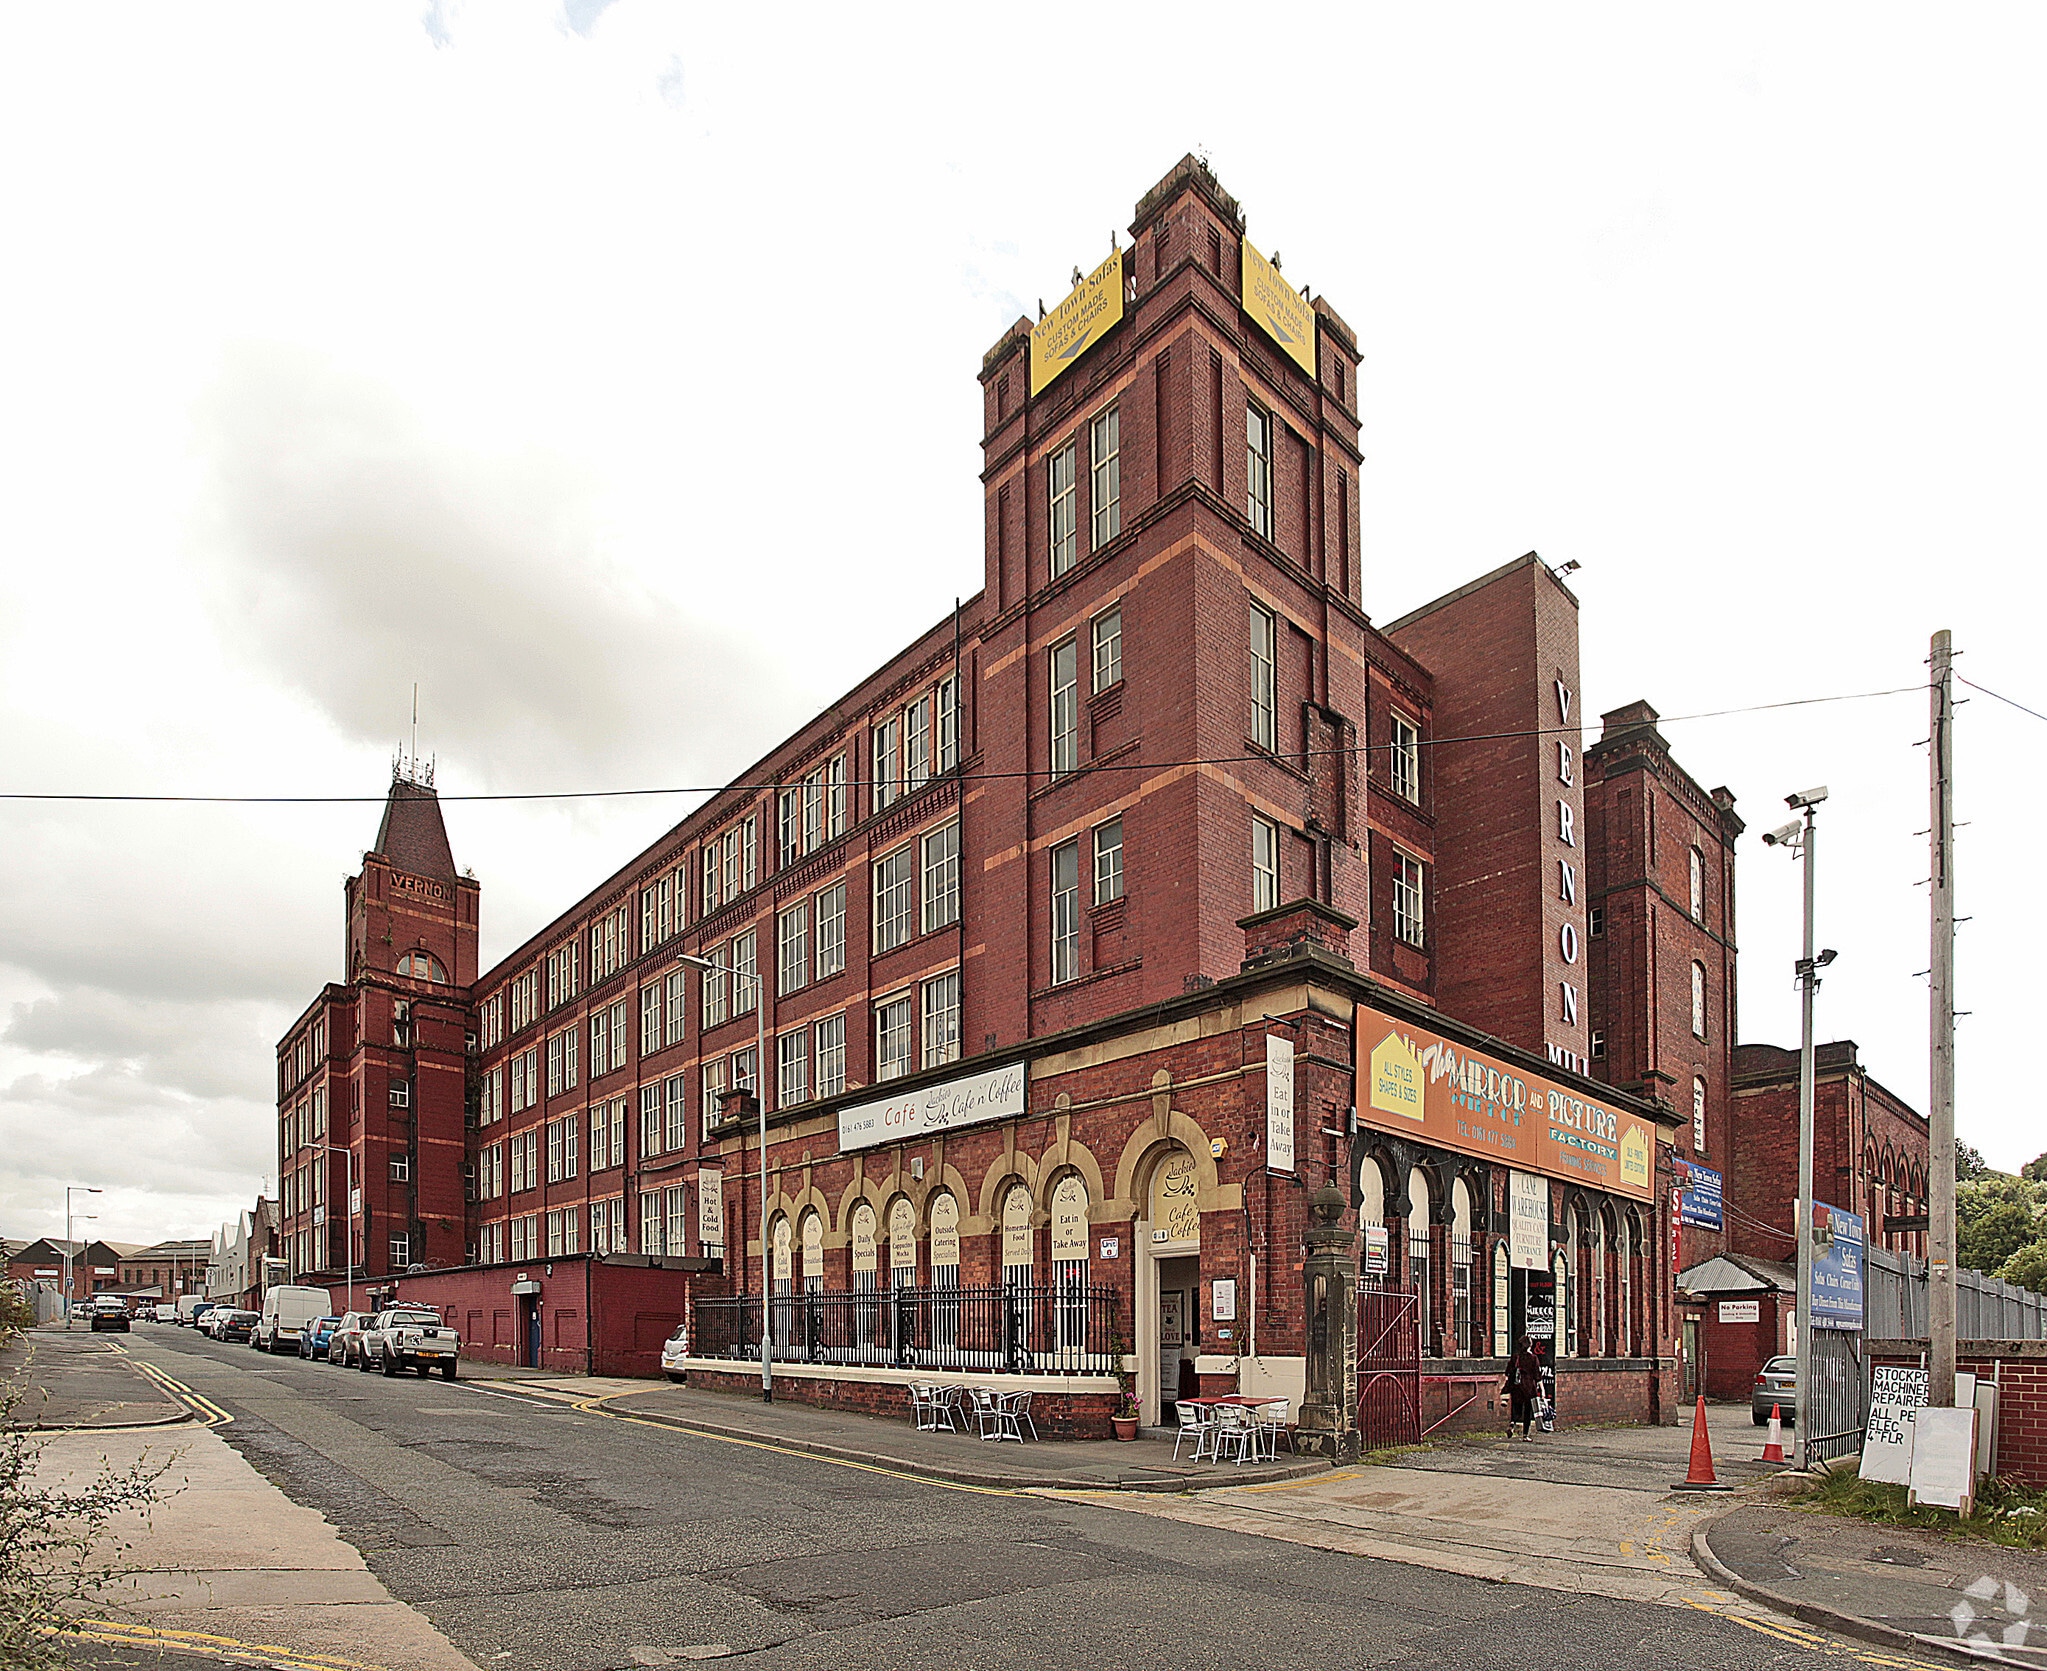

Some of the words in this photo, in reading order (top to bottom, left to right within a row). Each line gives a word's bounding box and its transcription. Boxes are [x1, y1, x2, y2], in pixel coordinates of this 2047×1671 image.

[1245, 241, 1264, 272] New
[1268, 265, 1290, 301] Town
[1292, 291, 1314, 326] Sofas
[1034, 316, 1055, 344] New
[1059, 288, 1086, 319] Town
[1088, 258, 1118, 292] Sofas
[1257, 277, 1284, 311] CUSTOM
[1285, 306, 1303, 332] MADE
[1047, 312, 1079, 348] CUSTOM
[1080, 289, 1104, 317] MADE
[1254, 285, 1275, 314] SOFAS
[1277, 309, 1282, 319] &
[1283, 316, 1306, 346] CHAIRS
[1044, 335, 1068, 362] SOFAS
[1071, 330, 1076, 339] &
[1077, 298, 1108, 331] CHAIRS
[1555, 679, 1579, 1027] VERNON
[391, 873, 452, 900] VERNON
[1384, 1061, 1393, 1076] ALL
[1394, 1064, 1413, 1083] STYLES
[952, 1090, 974, 1117] Cafe
[989, 1073, 1021, 1103] Coffee
[1274, 1086, 1288, 1101] Eat
[1379, 1077, 1397, 1097] SHAPES
[1403, 1086, 1417, 1103] SIZES
[1448, 1053, 1527, 1115] MIRROR
[1530, 1091, 1544, 1109] AND
[1547, 1089, 1618, 1143] PICTURE
[885, 1103, 915, 1127] Café
[1271, 1103, 1280, 1116] in
[1281, 1108, 1291, 1119] or
[842, 1123, 853, 1134] 0161
[853, 1121, 863, 1131] 476
[1271, 1120, 1291, 1136] Take
[1270, 1138, 1292, 1157] Away
[1551, 1130, 1616, 1158] FACTORY
[1521, 1175, 1537, 1195] CANE
[704, 1197, 717, 1206] Hot
[1512, 1195, 1546, 1220] WAREHOUSE
[703, 1215, 718, 1223] Cold
[1060, 1215, 1071, 1224] Eat
[1072, 1214, 1079, 1223] in
[1169, 1203, 1192, 1222] Cafe
[702, 1223, 719, 1232] Food
[935, 1225, 955, 1234] Outside
[1065, 1228, 1074, 1236] or
[1834, 1213, 1848, 1236] New
[858, 1235, 871, 1245] Daily
[935, 1238, 957, 1247] Catering
[1013, 1233, 1025, 1241] Food
[1053, 1240, 1068, 1249] Take
[1069, 1239, 1087, 1249] Away
[855, 1249, 875, 1259] Specials
[934, 1250, 958, 1259] Specialists
[1518, 1245, 1542, 1256] ENTRANCE
[1841, 1247, 1857, 1269] Sofas
[1161, 1305, 1177, 1313] TEA
[1161, 1332, 1180, 1340] LOVE
[1534, 1342, 1546, 1355] &
[1871, 1407, 1892, 1420] ALL
[1869, 1419, 1899, 1432] ELEC
